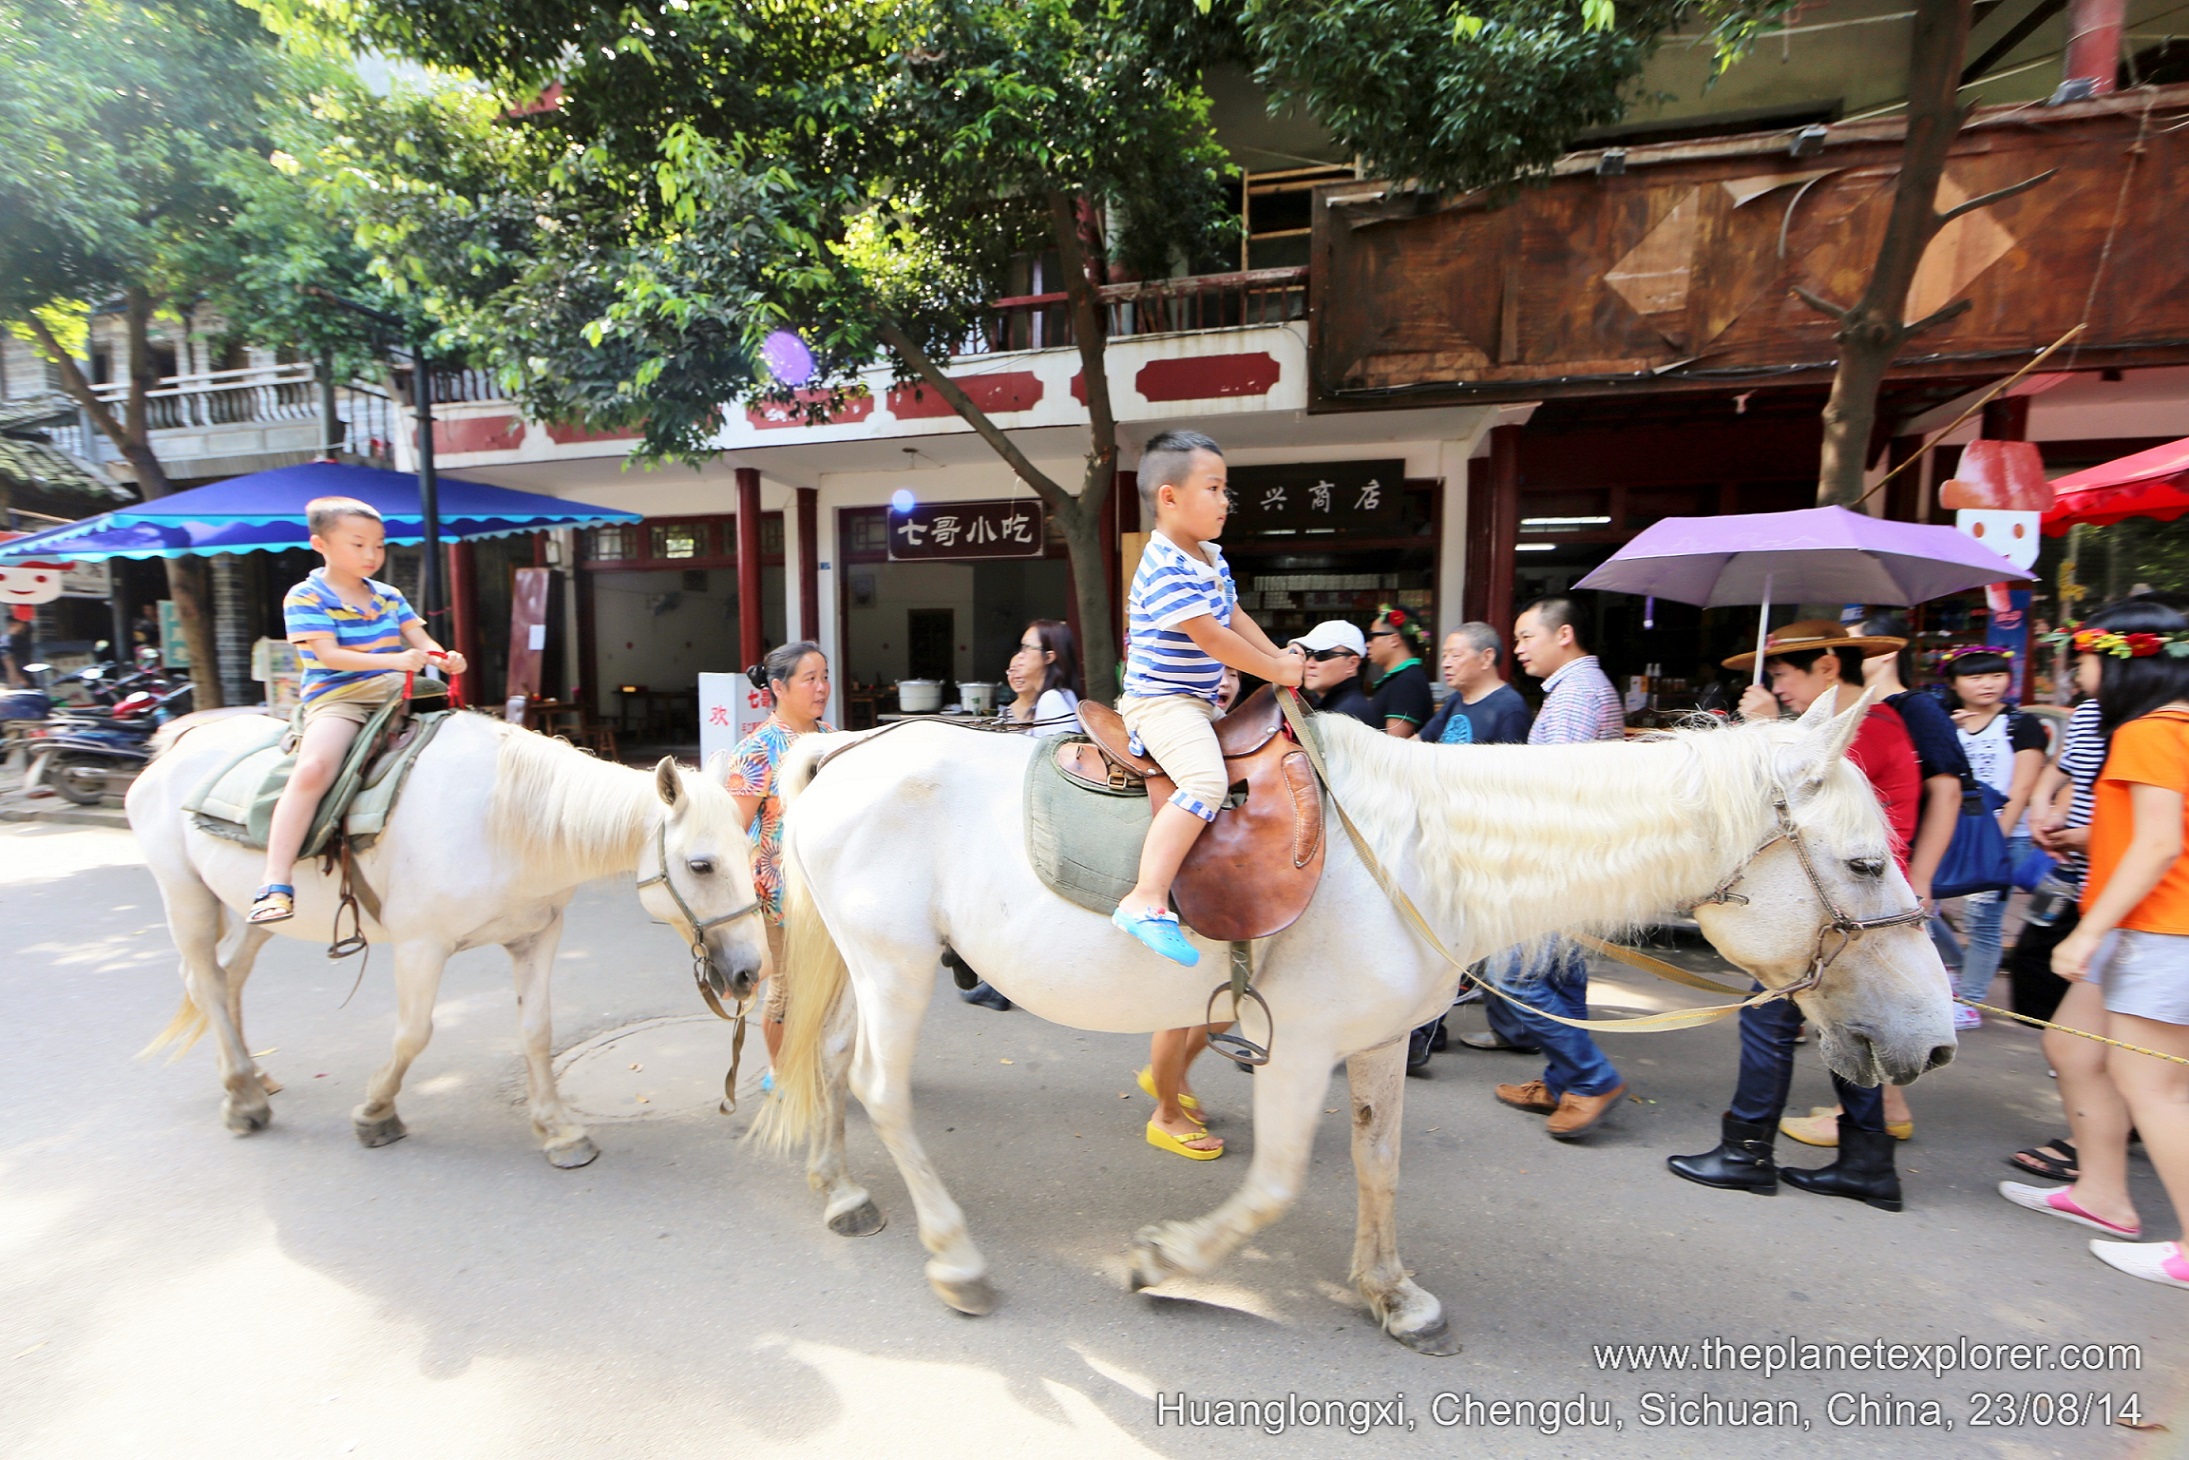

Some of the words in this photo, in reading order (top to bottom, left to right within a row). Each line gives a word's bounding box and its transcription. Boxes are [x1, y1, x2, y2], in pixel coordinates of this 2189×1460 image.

[897, 513, 1033, 547] 七哥小吃
[709, 704, 729, 727] 欢
